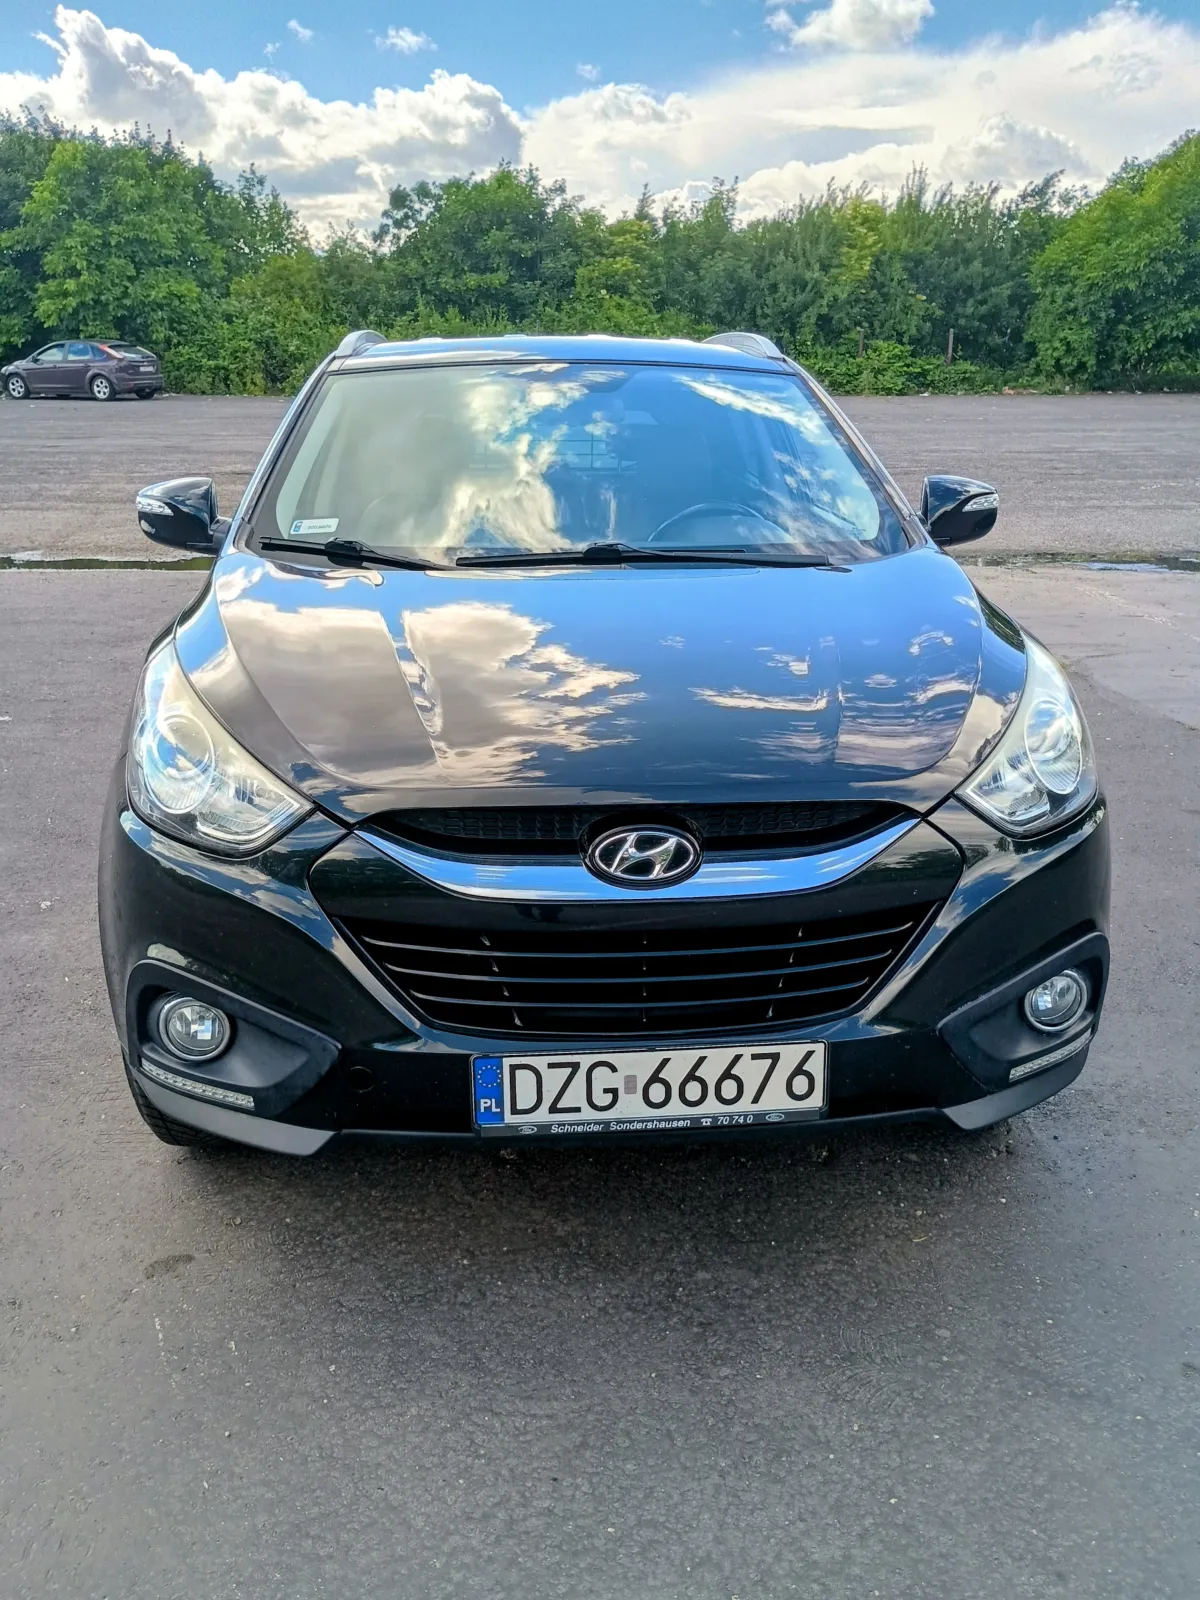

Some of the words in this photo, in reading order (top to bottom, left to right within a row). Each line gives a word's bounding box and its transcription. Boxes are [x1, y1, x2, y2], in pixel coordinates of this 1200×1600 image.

[508, 1060, 619, 1116] DZG
[642, 1050, 816, 1110] 66676
[480, 1098, 500, 1113] PL
[551, 1123, 603, 1133] Schneider
[609, 1119, 690, 1131] Sondershausen
[717, 1116, 729, 1125] 70
[732, 1115, 744, 1124] 74
